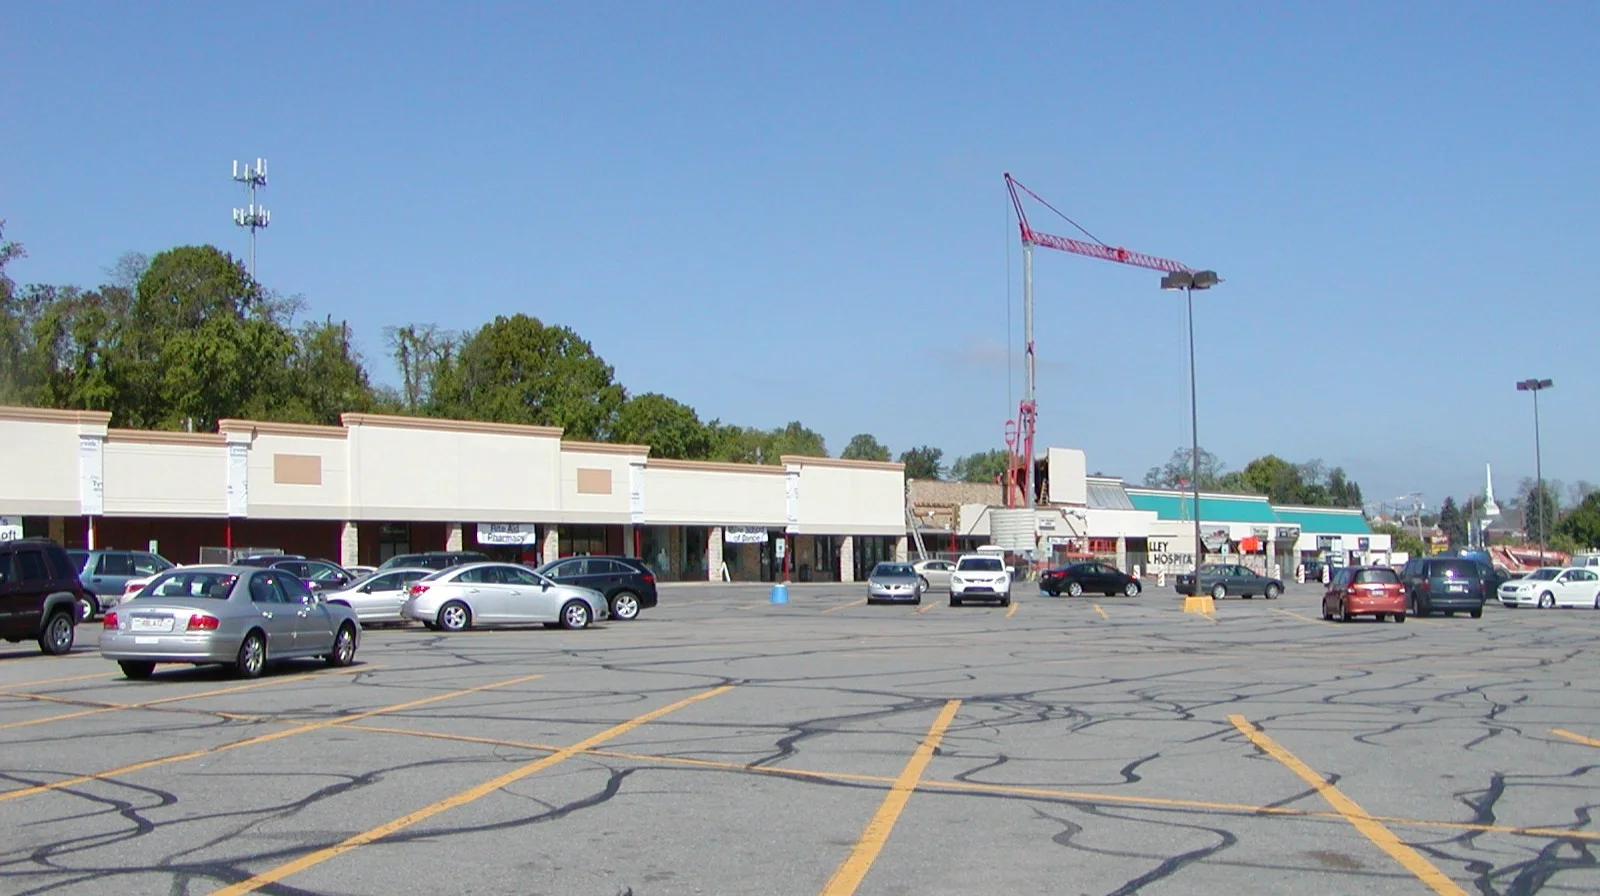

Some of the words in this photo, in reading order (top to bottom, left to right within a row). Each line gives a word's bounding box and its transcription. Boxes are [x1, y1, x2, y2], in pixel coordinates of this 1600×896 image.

[490, 523, 506, 533] Rite
[506, 523, 520, 533] Aid
[487, 532, 525, 544] Pharmacy
[742, 534, 761, 543] Dance
[1149, 541, 1169, 552] LLEY
